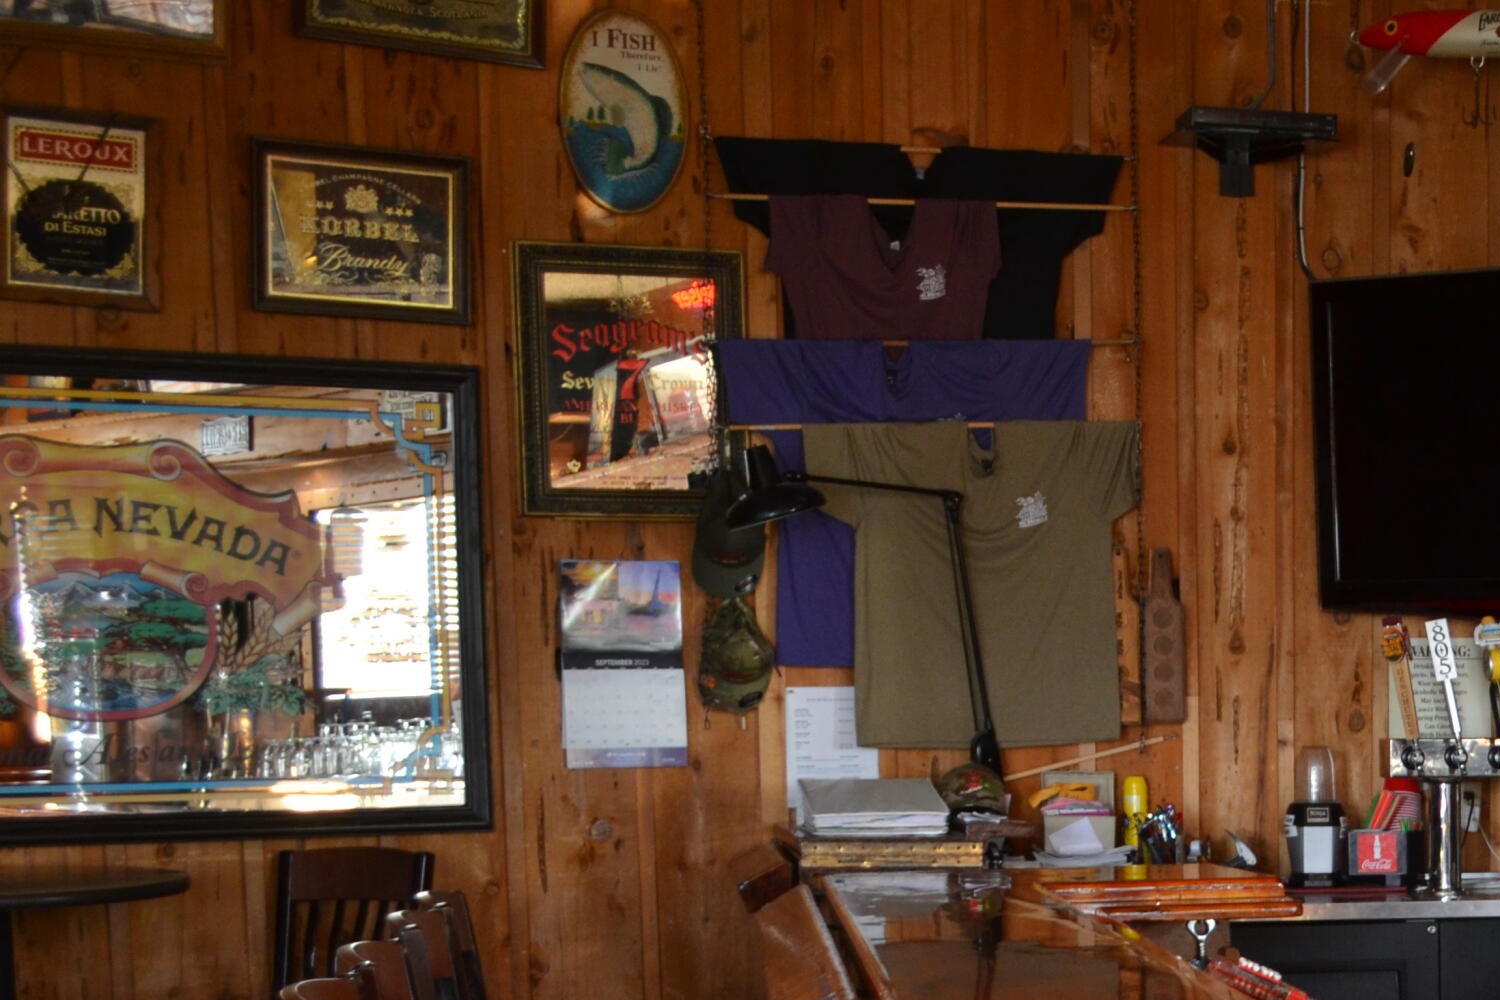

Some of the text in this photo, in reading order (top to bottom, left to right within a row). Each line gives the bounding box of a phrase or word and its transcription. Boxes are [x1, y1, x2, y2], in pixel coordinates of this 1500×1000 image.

[591, 28, 657, 50] I FISH
[22, 136, 131, 162] LEROUX
[44, 221, 60, 233] DI
[300, 215, 420, 243] KORBEL
[319, 241, 411, 277] Brandy
[551, 318, 711, 364] Seagram's
[616, 358, 649, 400] 7
[93, 496, 292, 576] NEVADA
[595, 659, 633, 667] SEPTEMBER
[1432, 624, 1452, 675] 805
[1361, 858, 1393, 871] Coca-Cola
